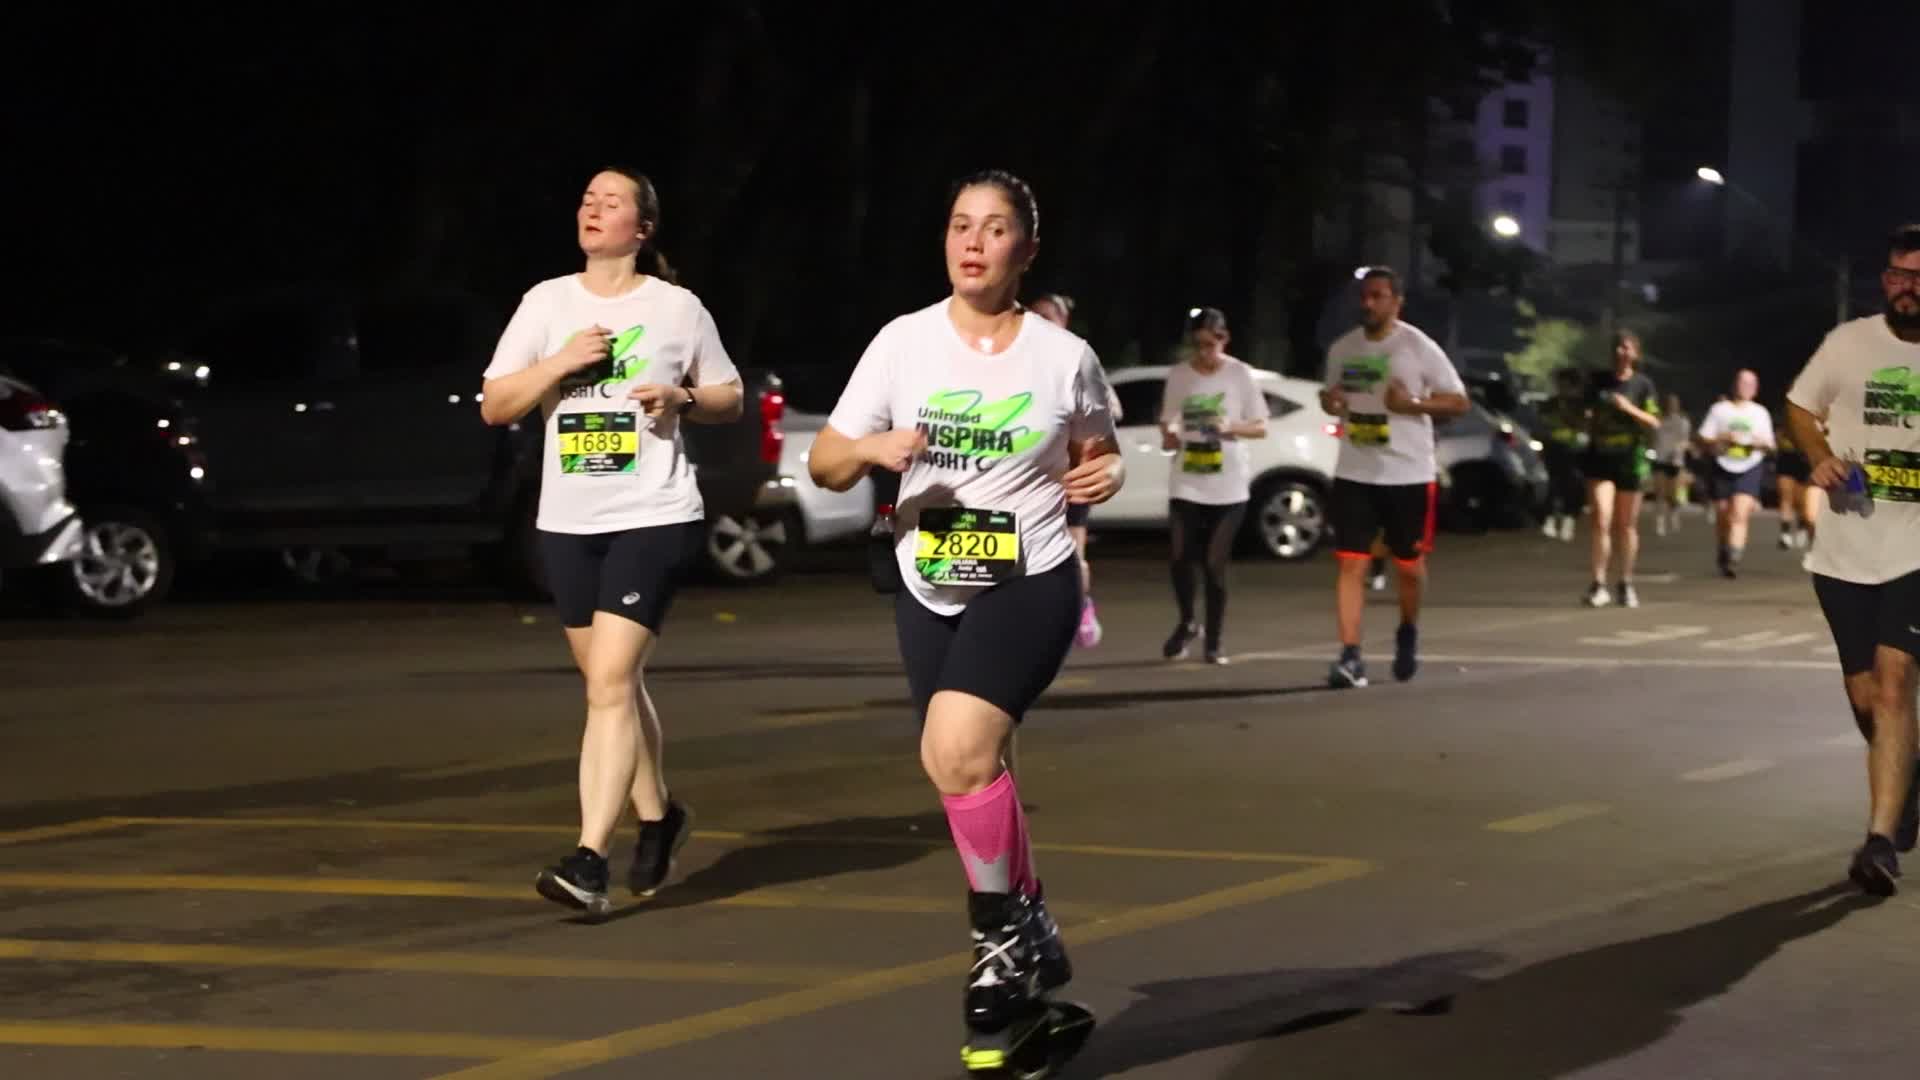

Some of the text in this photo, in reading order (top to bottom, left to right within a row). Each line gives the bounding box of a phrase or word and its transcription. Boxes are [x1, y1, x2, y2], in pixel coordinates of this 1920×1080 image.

[917, 407, 981, 424] Unimed
[571, 432, 622, 452] 1689
[1874, 467, 1919, 487] 2901
[932, 533, 998, 557] 2820
